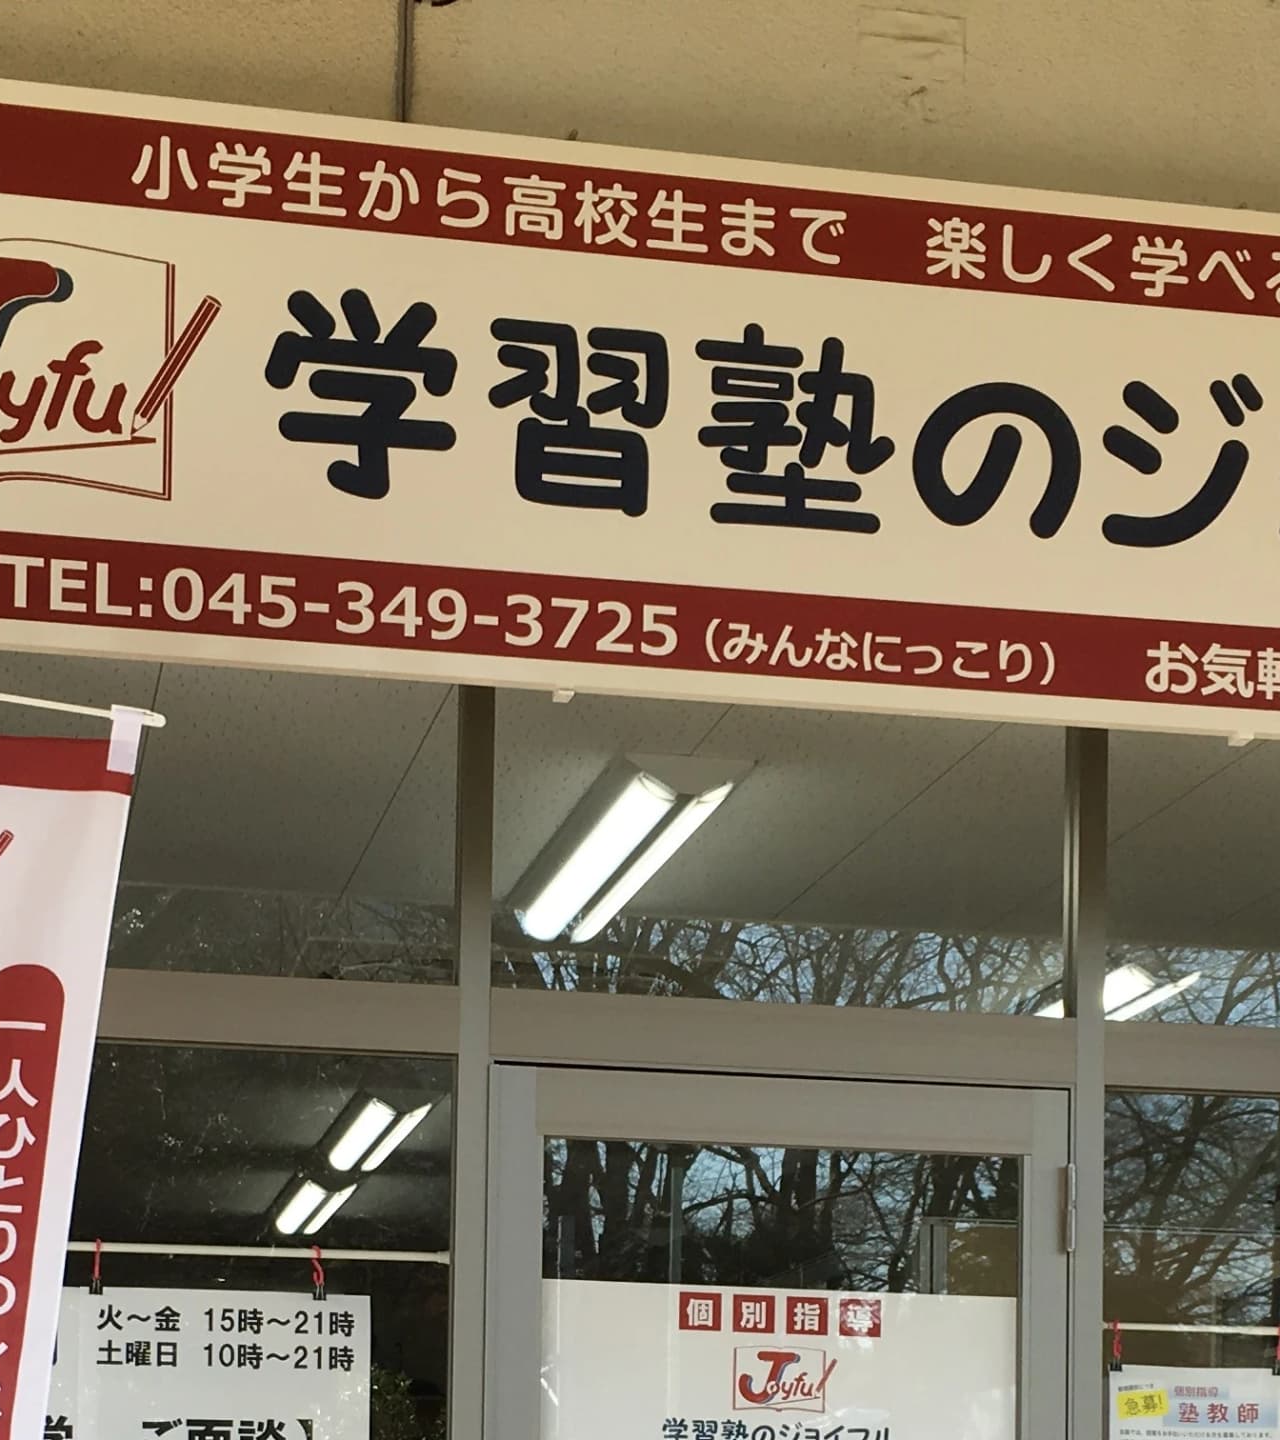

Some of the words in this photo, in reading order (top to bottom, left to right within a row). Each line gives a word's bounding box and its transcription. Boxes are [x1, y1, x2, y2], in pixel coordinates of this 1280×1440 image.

[131, 136, 847, 266] 小学生から高校生まで
[204, 1307, 355, 1337] 15時～21時
[686, 1298, 875, 1335] 個別指導
[96, 1341, 178, 1369] 土曜日
[203, 1343, 355, 1371] 10時～21時
[1178, 1402, 1260, 1424] 塾教師
